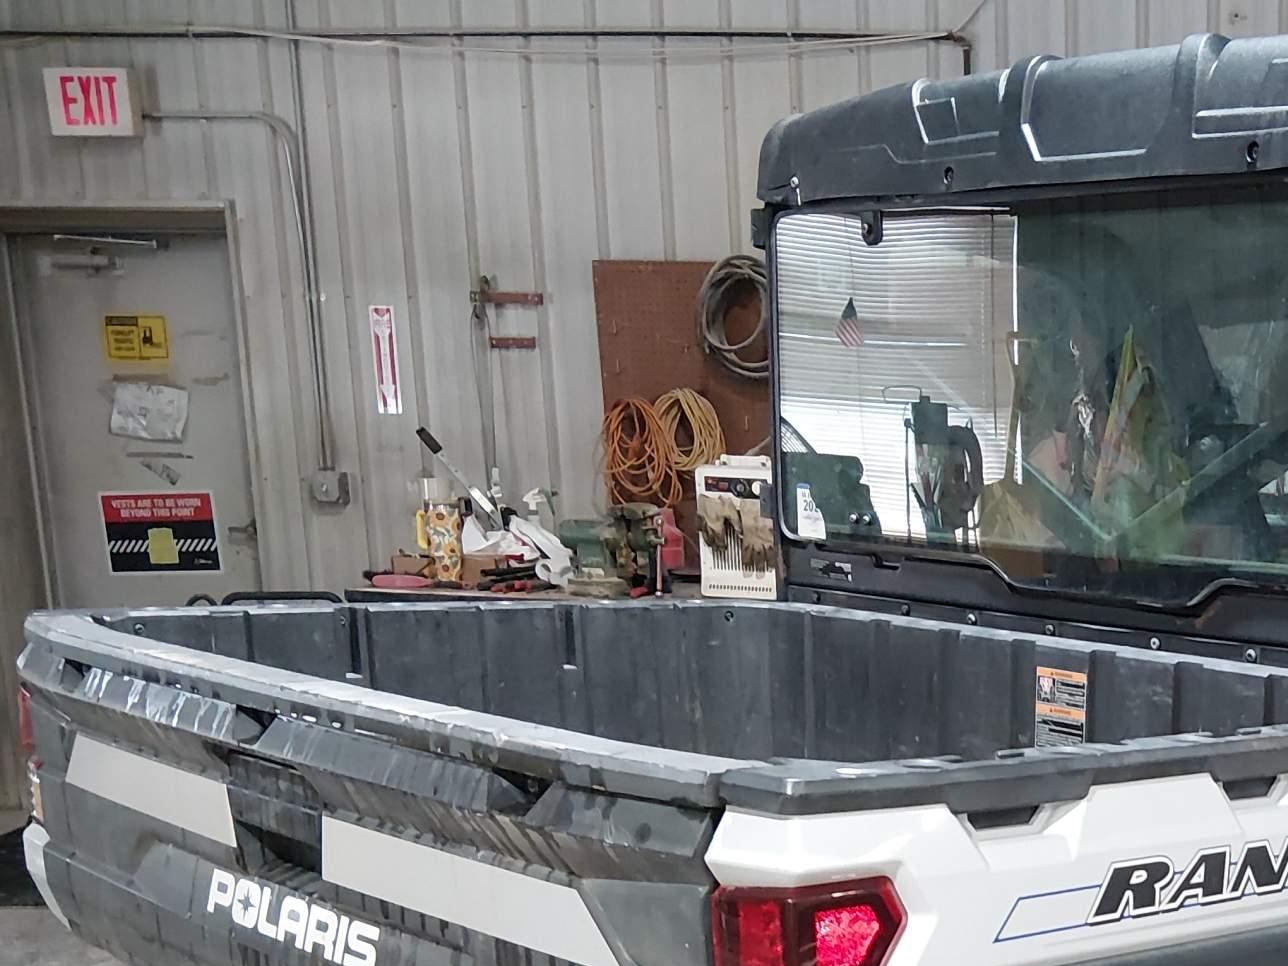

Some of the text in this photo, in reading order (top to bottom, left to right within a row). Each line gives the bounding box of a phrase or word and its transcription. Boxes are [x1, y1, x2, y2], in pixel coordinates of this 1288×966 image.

[59, 76, 118, 126] EXIT
[111, 497, 201, 508] VESTS ARE TO BE WORN
[120, 507, 195, 518] BEYOND THIS POINT
